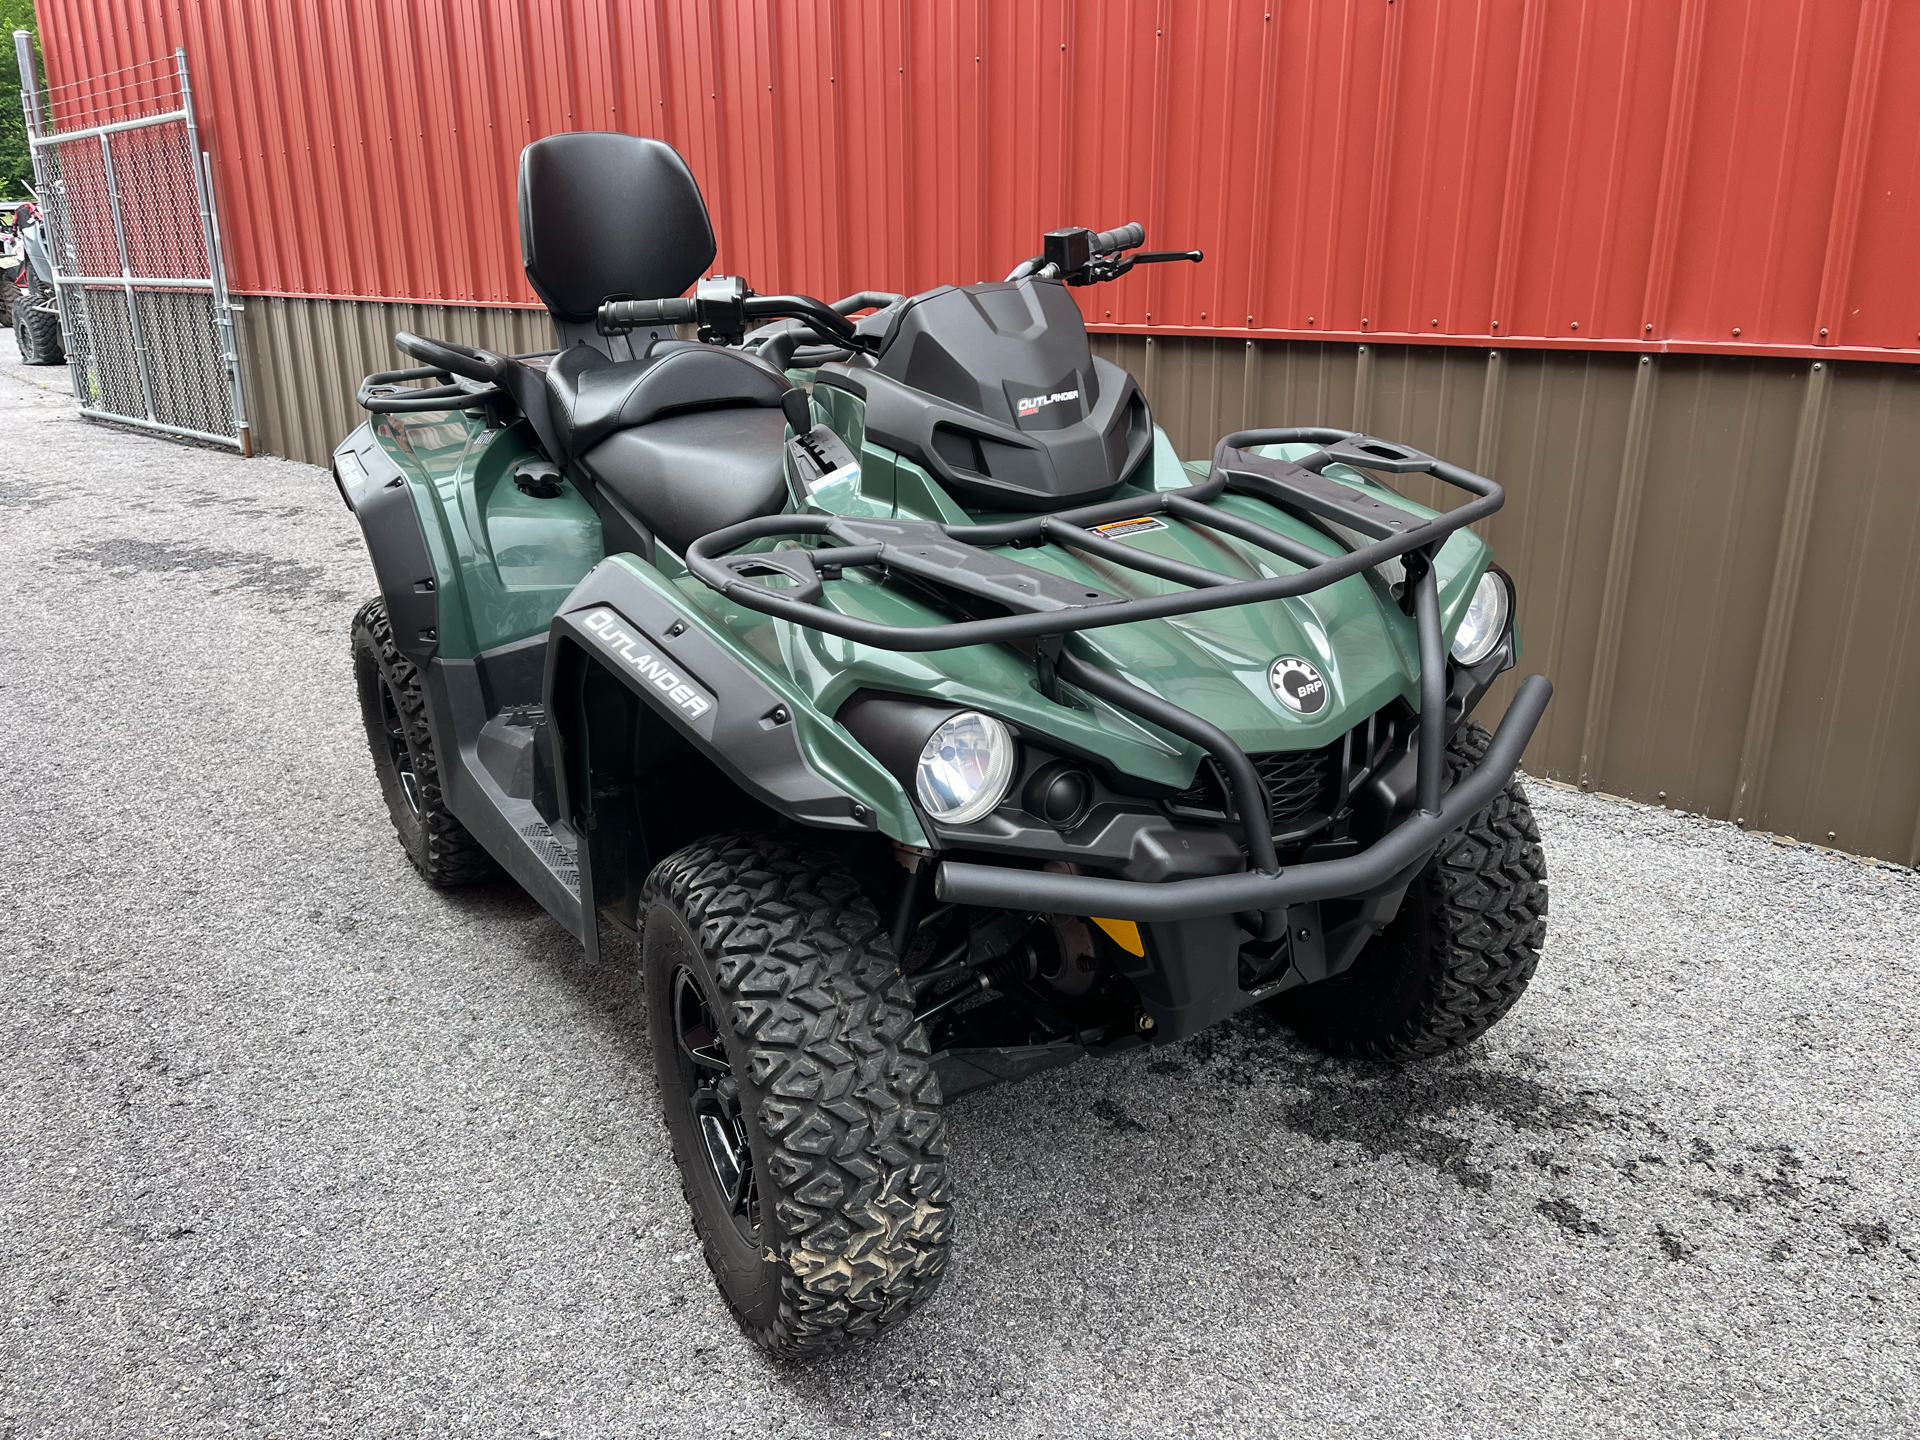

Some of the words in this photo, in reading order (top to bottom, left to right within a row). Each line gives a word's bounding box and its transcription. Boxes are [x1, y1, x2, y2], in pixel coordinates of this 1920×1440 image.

[1019, 390, 1079, 410] OUTLANDER
[584, 610, 709, 717] OUTLANDER
[1297, 680, 1323, 698] BRP
